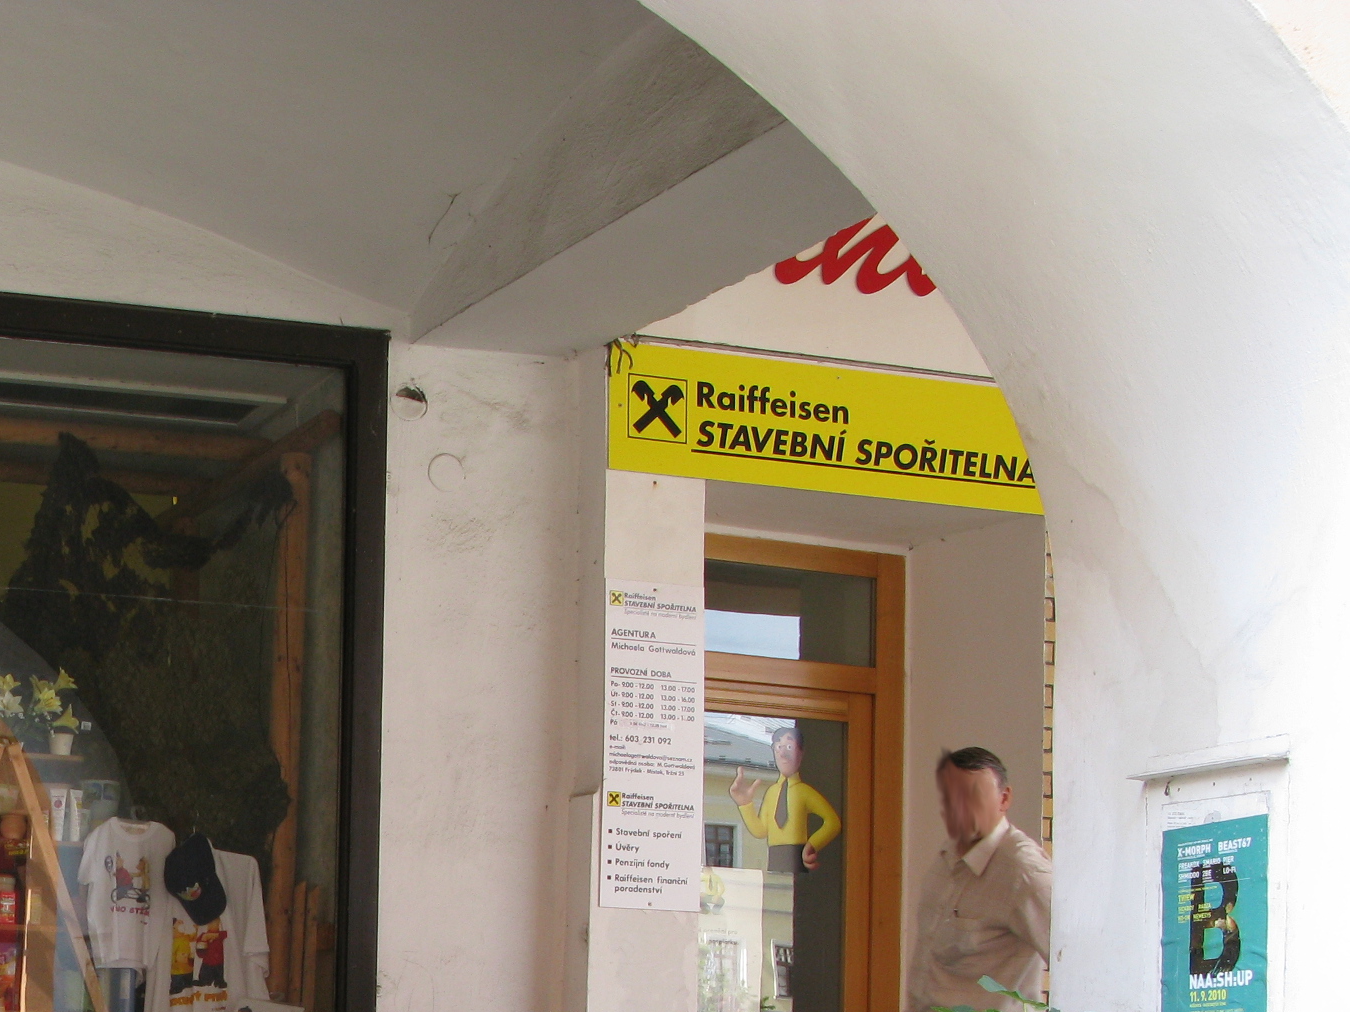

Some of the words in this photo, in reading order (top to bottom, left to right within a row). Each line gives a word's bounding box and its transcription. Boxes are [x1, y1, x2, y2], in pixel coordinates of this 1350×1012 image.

[696, 381, 850, 425] Raiffeisen
[697, 419, 847, 462] STAVEBNÍ
[855, 438, 1036, 484] SPOŘITELNA
[624, 593, 656, 602] Raiffeisen
[624, 601, 655, 609] STAVEBNÍ
[657, 603, 697, 613] SPOŘITELNA
[611, 628, 656, 639] AGENTURA
[611, 642, 645, 652] Michaela
[648, 645, 696, 656] Gottwaldová
[610, 667, 648, 677] PROVOZNÍ
[650, 670, 672, 678] DOBA
[609, 734, 623, 742] tel.:
[625, 735, 639, 743] 603
[643, 736, 655, 744] 231
[658, 737, 672, 745] 092
[622, 793, 654, 801] Raiffeisen
[622, 800, 653, 808] STAVEBNÍ
[655, 802, 695, 811] SPOŘITELNA
[615, 827, 650, 837] Stavební
[652, 831, 682, 839] spoření
[615, 841, 640, 853] Úvěry
[1177, 843, 1212, 858] X-MORPH
[1218, 837, 1252, 851] BEAST67
[615, 858, 646, 868] Penzijní
[647, 860, 670, 870] fondy
[614, 874, 653, 884] Raiffeisen
[657, 875, 689, 885] finanční
[614, 885, 663, 894] poradenství
[1208, 989, 1227, 1000] 2010
